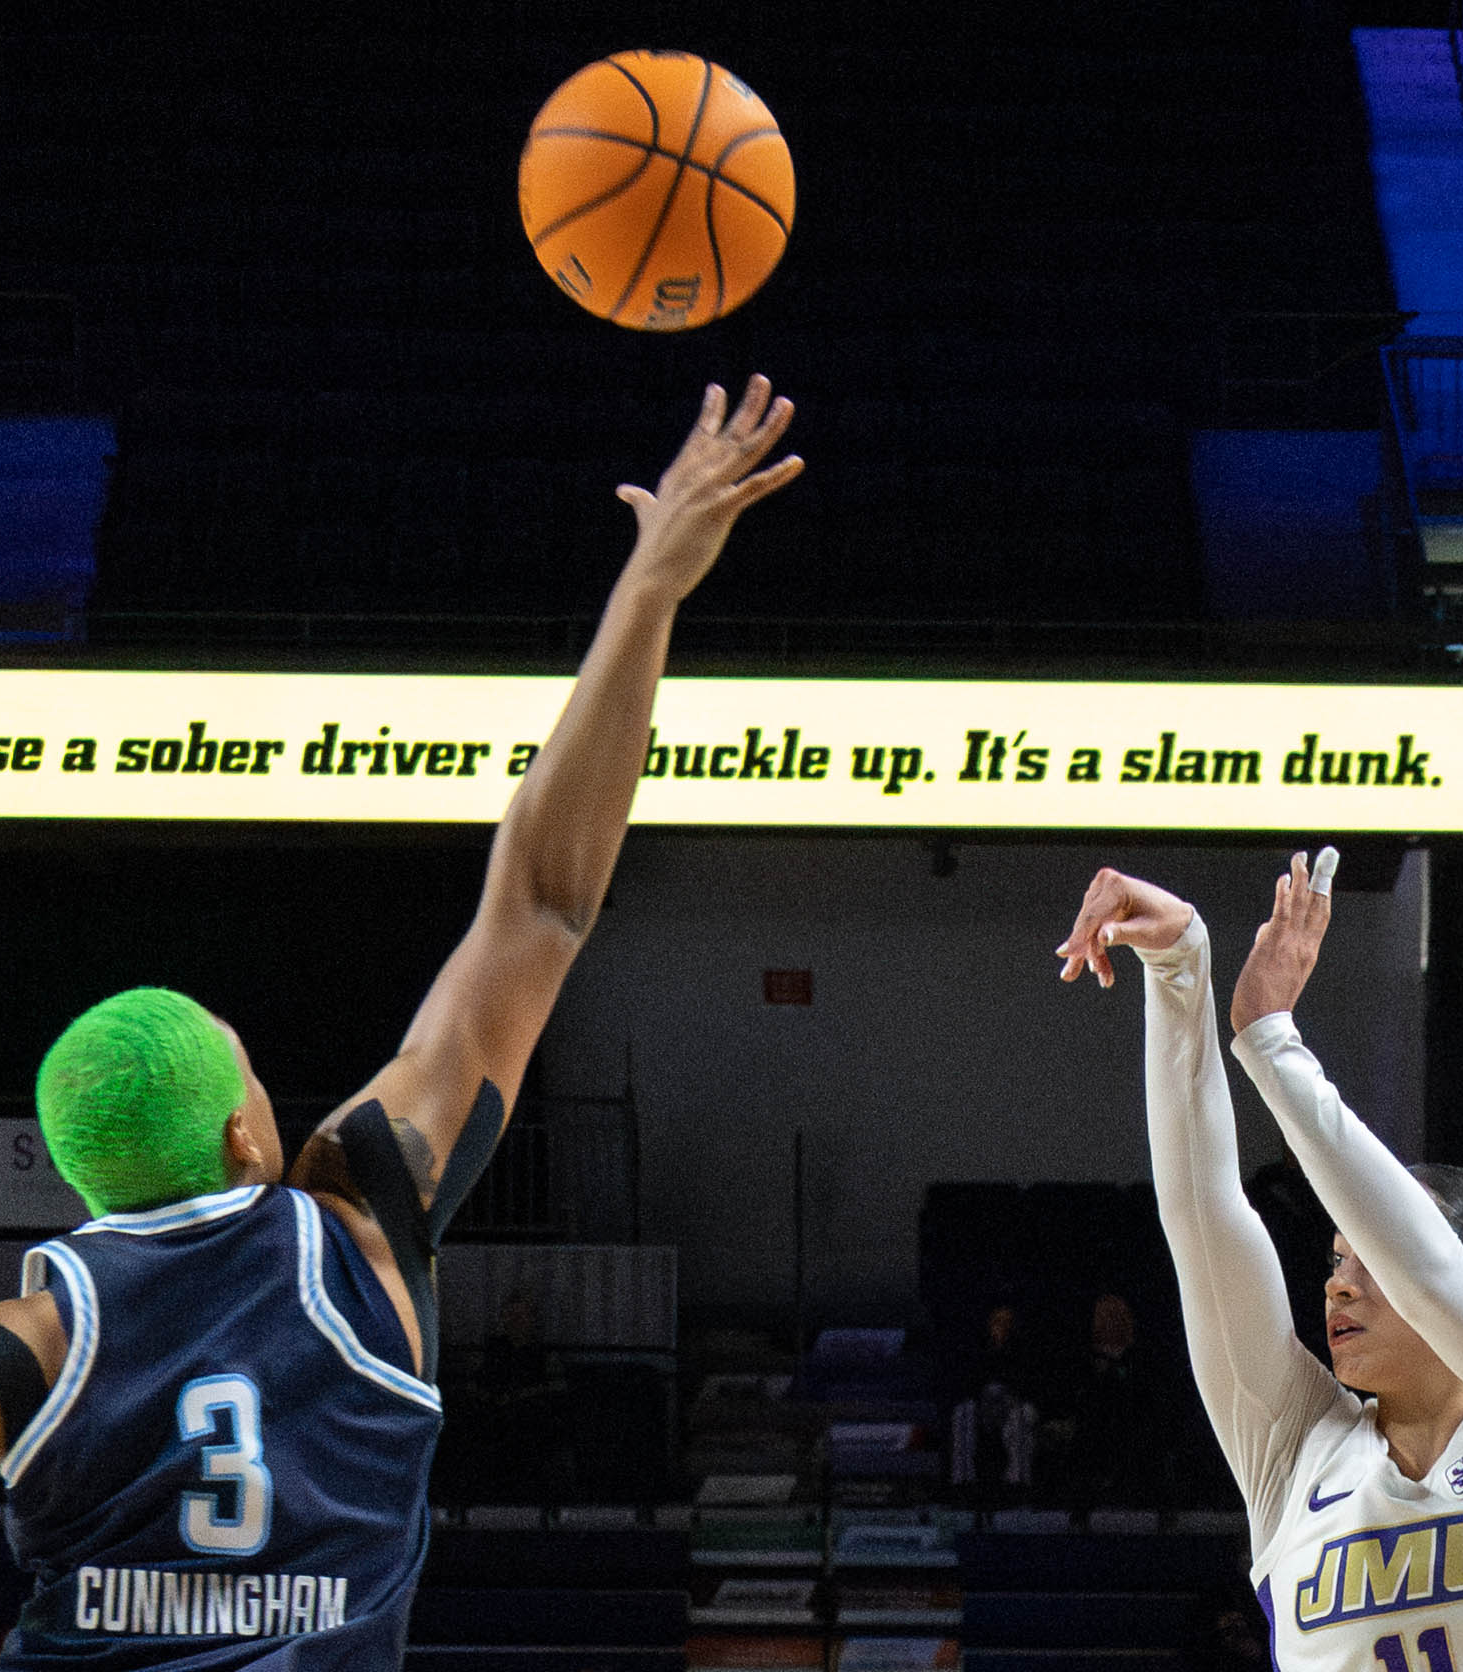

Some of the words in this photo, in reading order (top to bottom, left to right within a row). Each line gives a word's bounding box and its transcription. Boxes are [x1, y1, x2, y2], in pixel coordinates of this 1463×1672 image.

[62, 739, 97, 773] a
[115, 721, 283, 776] sober
[301, 724, 490, 777] driver
[643, 727, 828, 780] buckle
[851, 745, 936, 795] up.
[959, 729, 1049, 783] It's
[1067, 746, 1102, 783] a
[1121, 732, 1261, 785] slam
[1282, 735, 1443, 788] dunk.
[176, 1373, 273, 1556] 3
[77, 1566, 348, 1636] CUNNINGHAM
